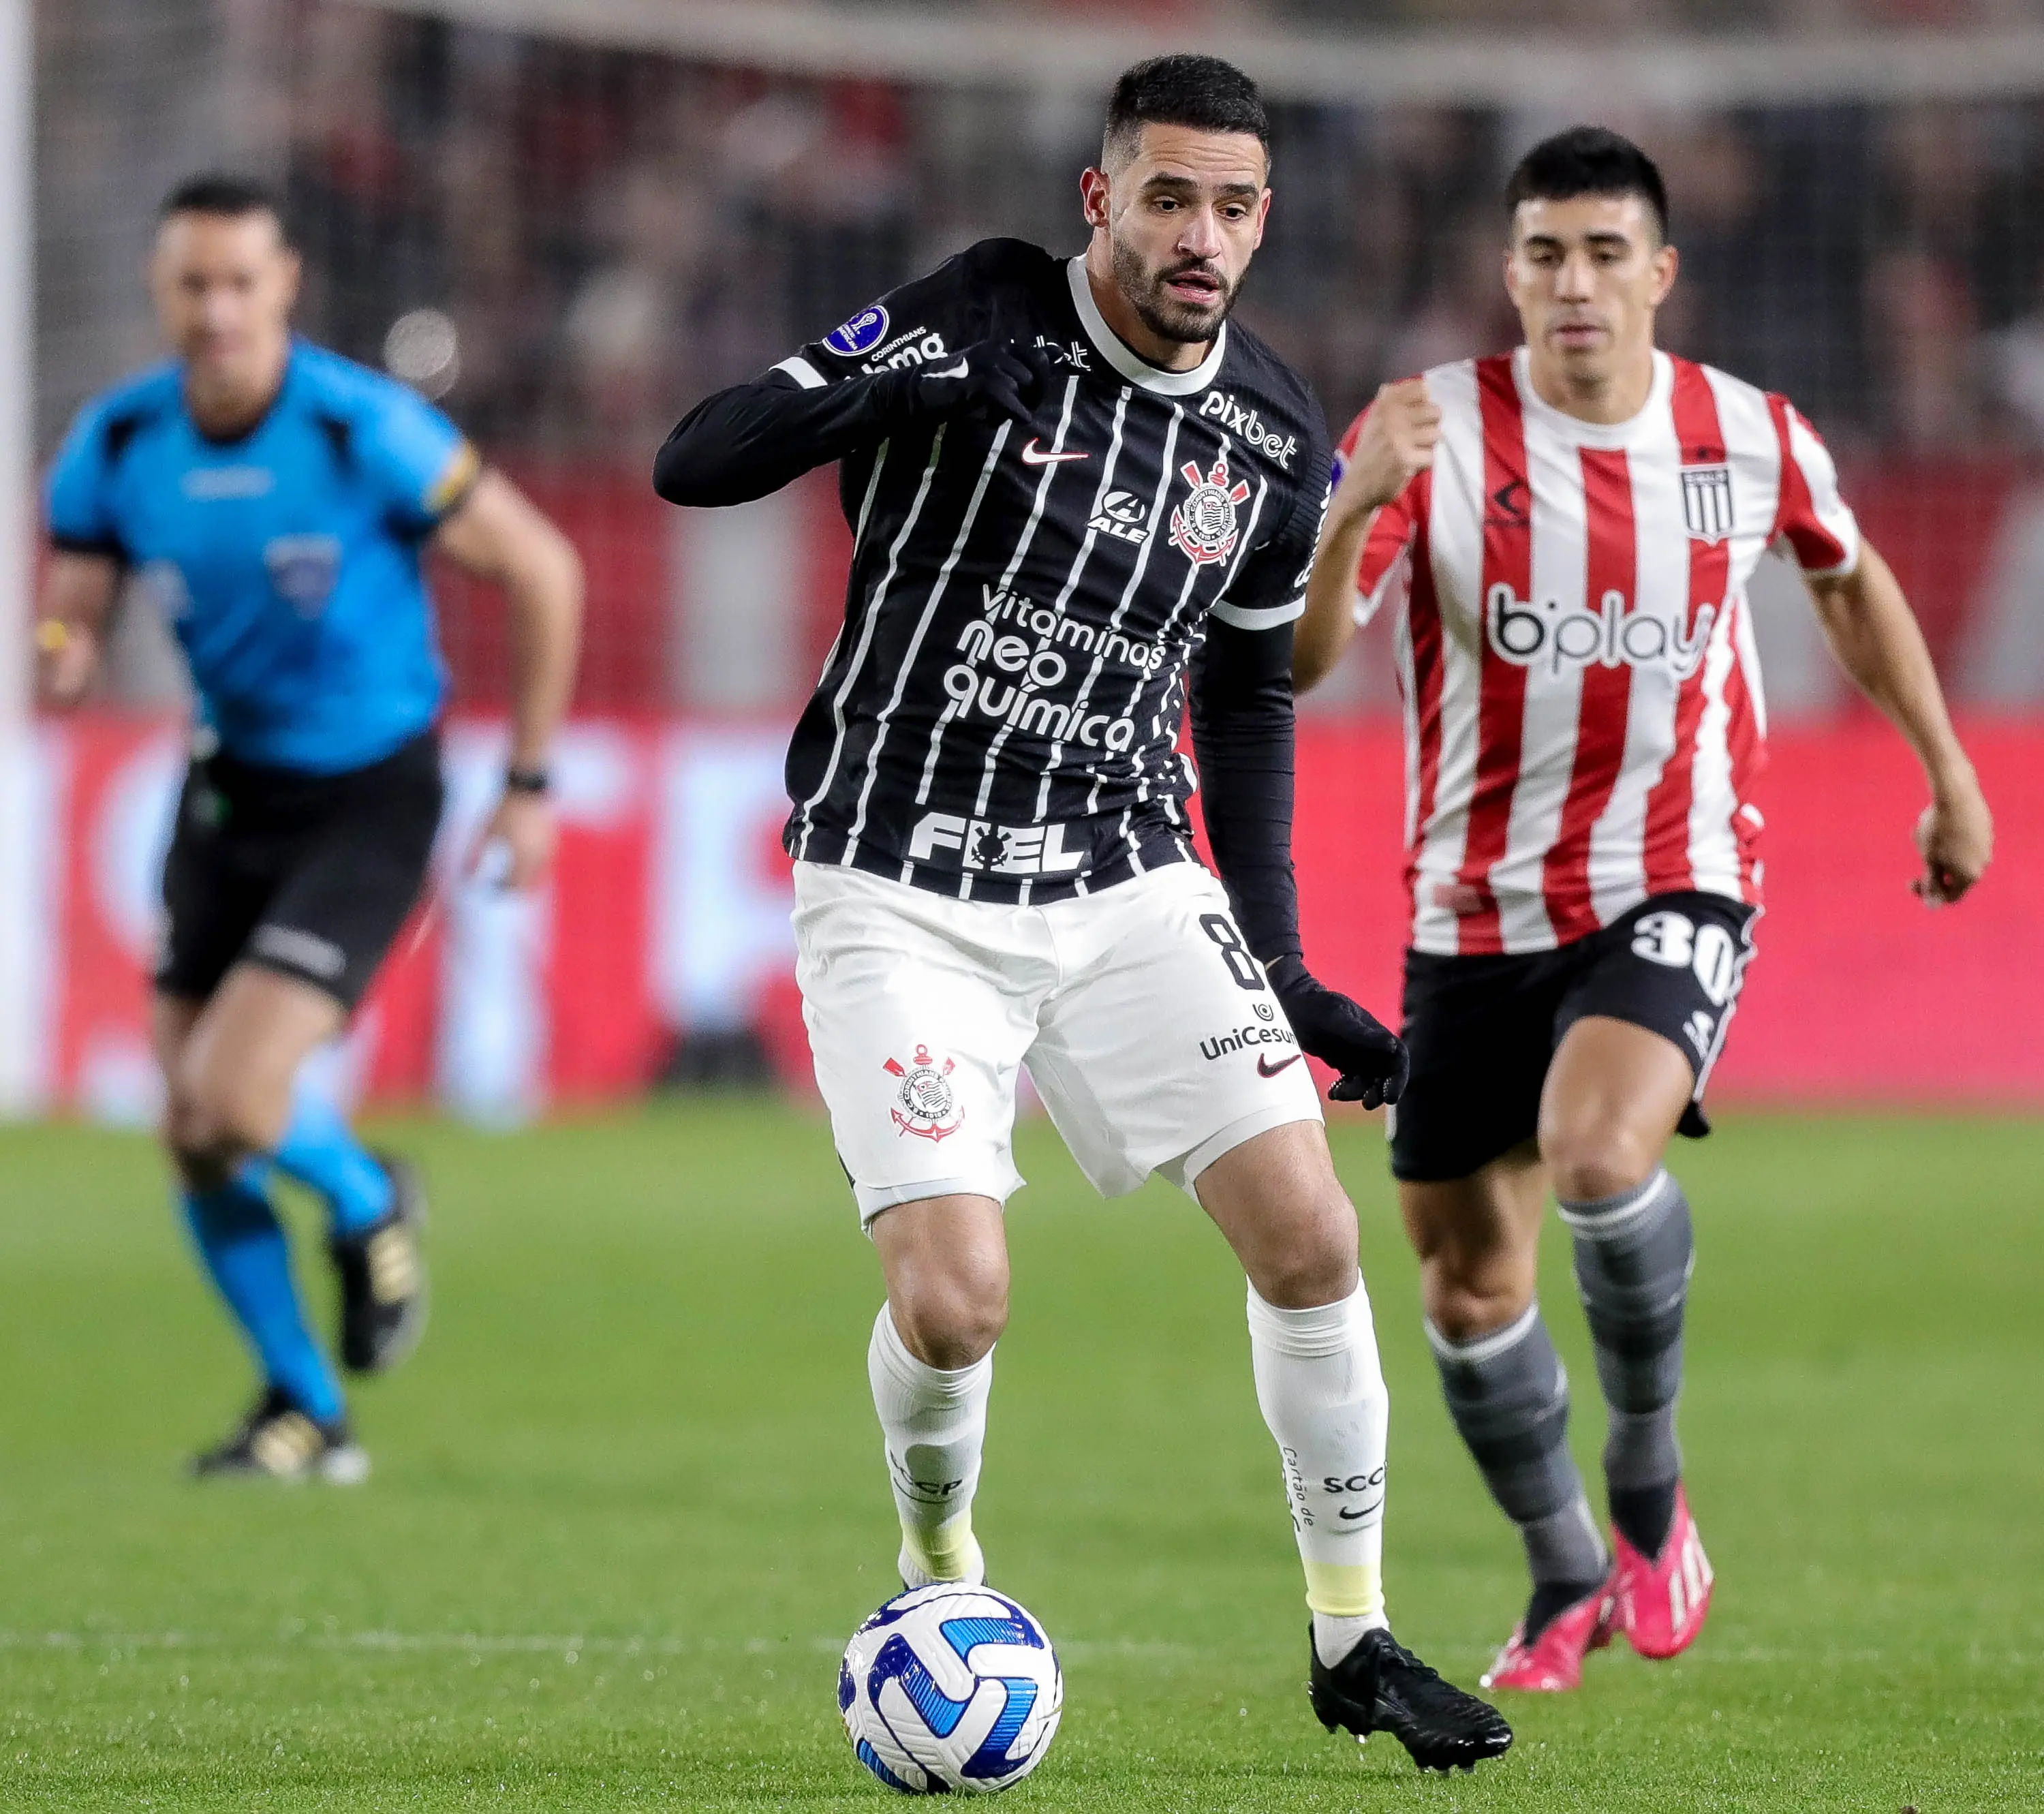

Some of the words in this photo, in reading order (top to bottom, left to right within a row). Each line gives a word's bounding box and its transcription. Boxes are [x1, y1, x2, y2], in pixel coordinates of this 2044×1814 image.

[871, 326, 927, 362] CORINTHIANS
[1198, 390, 1297, 470] pixbet
[1087, 517, 1148, 544] ALE
[957, 620, 1066, 686] neo
[944, 664, 1135, 752] química
[1199, 914, 1265, 990] 8
[1630, 910, 1735, 1007] 30
[1283, 1447, 1308, 1501] Cartão
[1301, 1507, 1315, 1526] de
[1323, 1460, 1389, 1493] SCC
